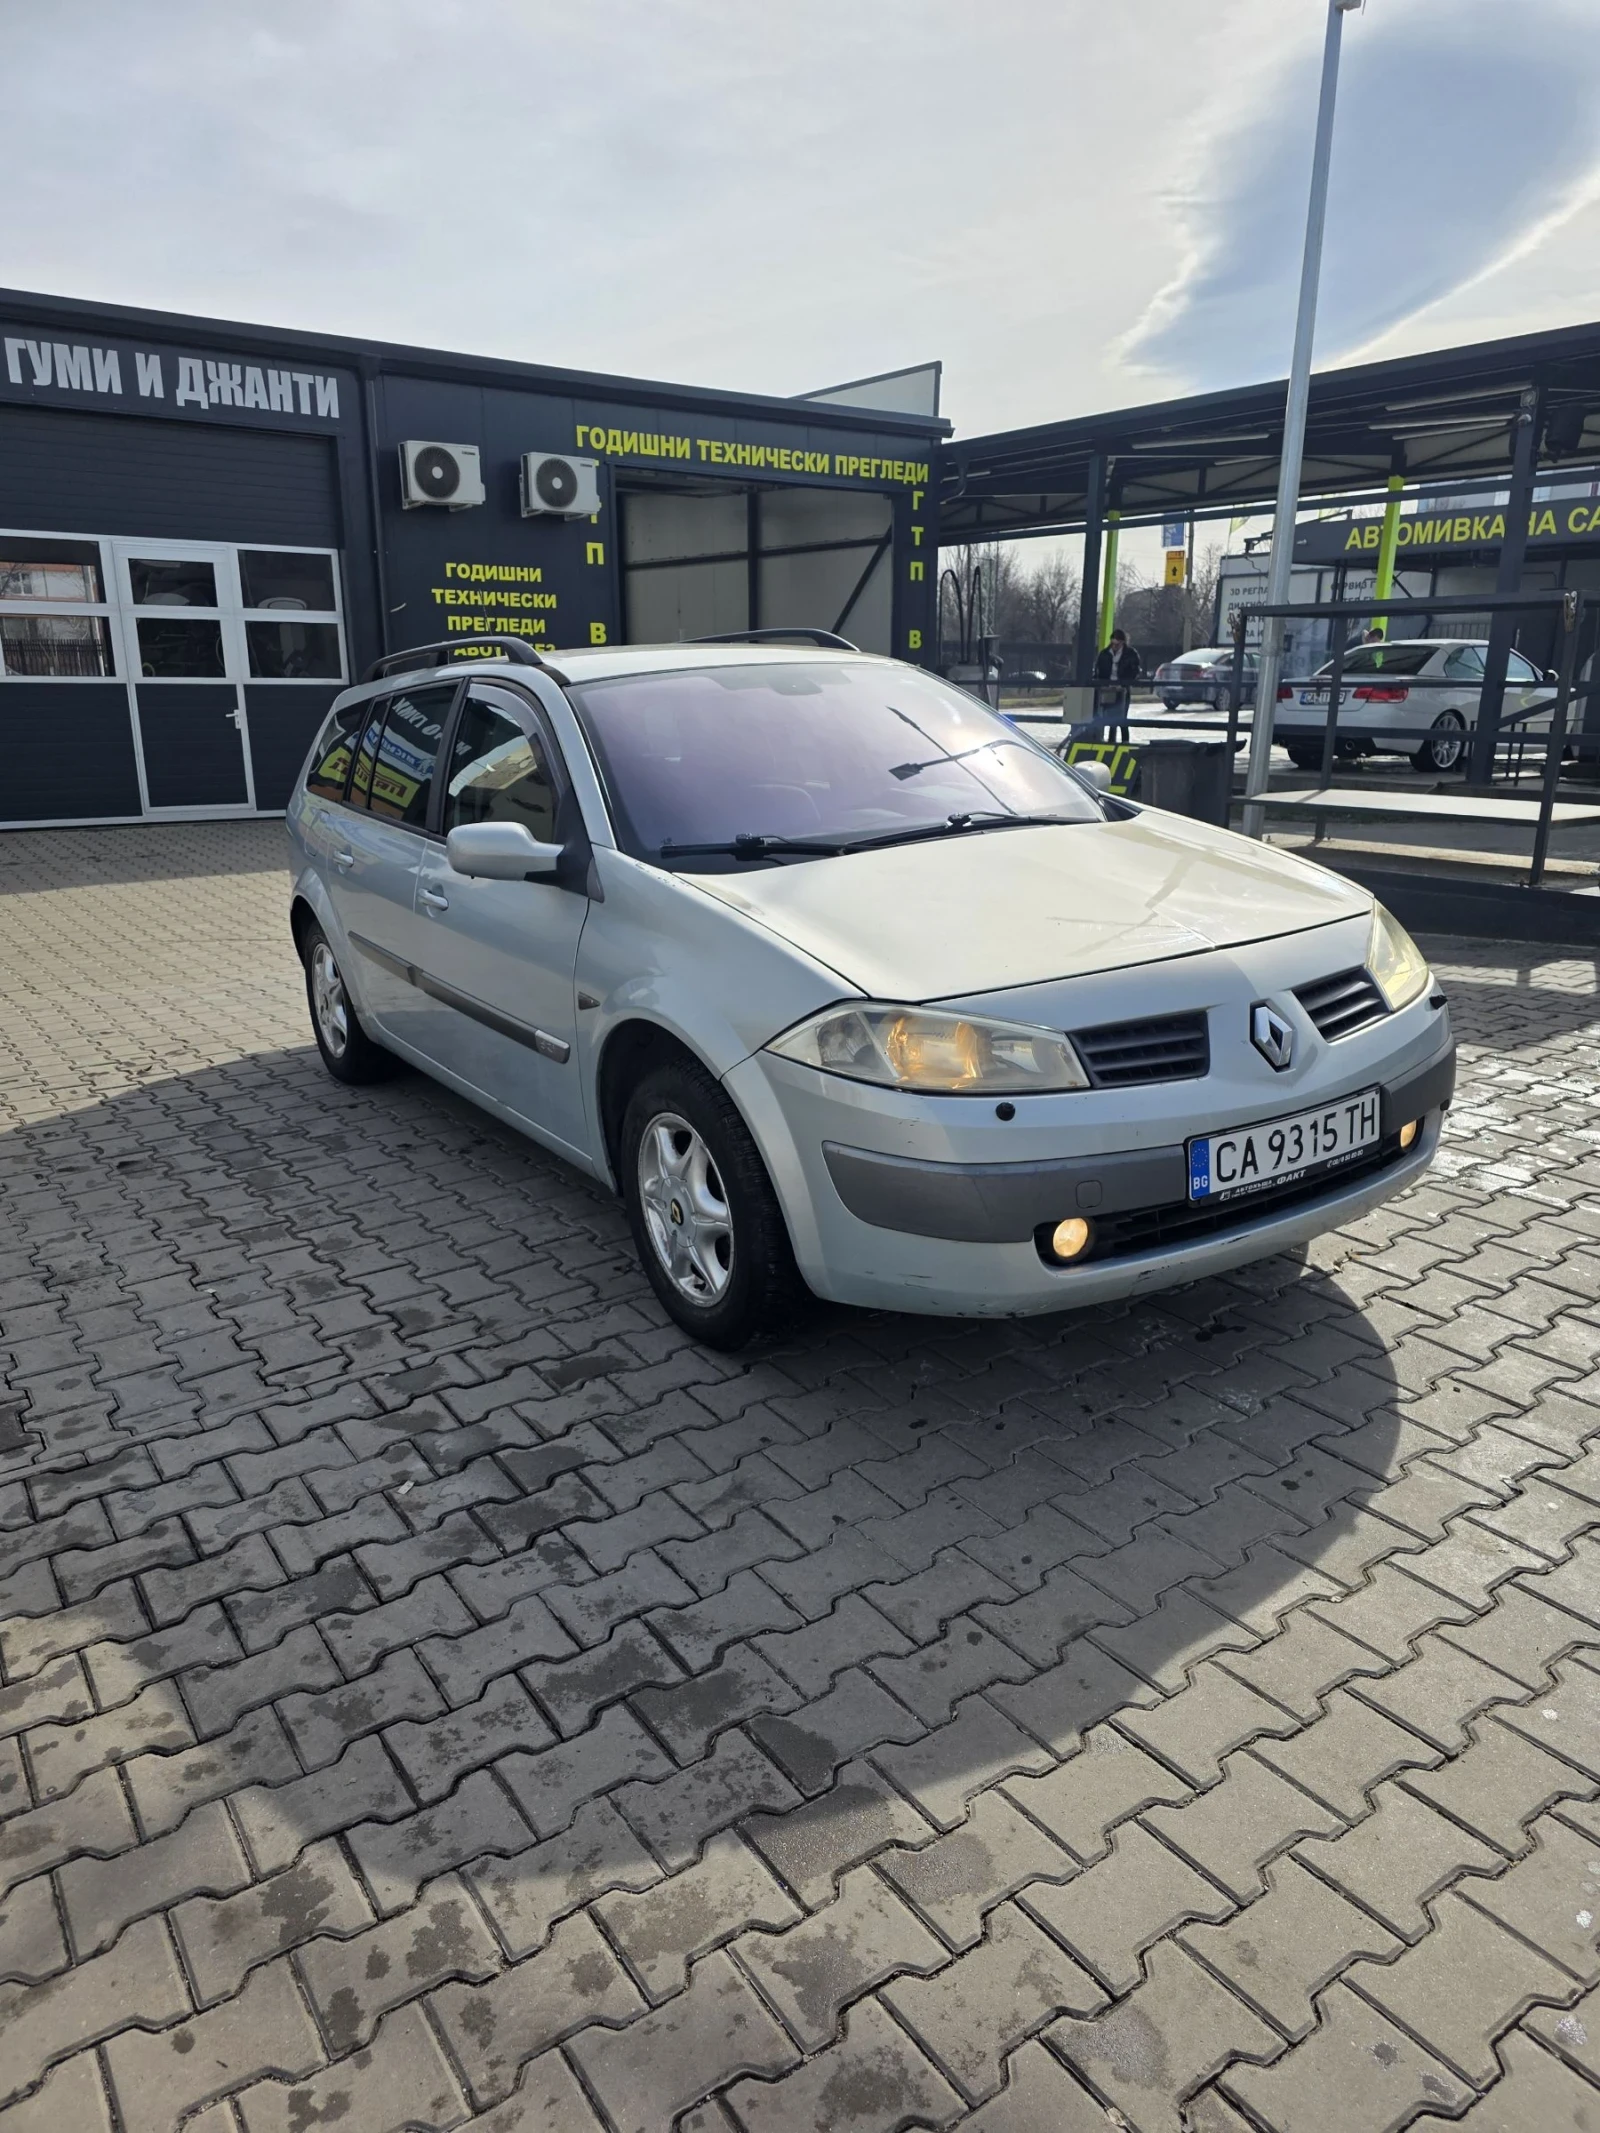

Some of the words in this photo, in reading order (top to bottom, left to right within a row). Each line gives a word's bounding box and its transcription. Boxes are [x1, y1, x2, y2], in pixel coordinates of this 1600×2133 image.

[4, 337, 123, 394] ГУМИ
[135, 352, 164, 398] И
[176, 356, 340, 418] ДЖАНТИ
[576, 425, 690, 459] ГОДИШНИ
[696, 439, 830, 474] ТЕХНИЧЕСКИ
[834, 454, 929, 485] ПРЕГЛЕДИ
[1344, 514, 1506, 550] АВОМИВКА
[445, 562, 542, 582] ГОДИШНИ
[431, 588, 557, 609] ТЕХНИЧЕСКИ
[447, 615, 546, 636] ПРЕГЛЕДИ
[1216, 1135, 1259, 1182] CA
[1268, 1111, 1338, 1170] 9315
[1345, 1098, 1376, 1144] TH
[1193, 1175, 1208, 1190] BG
[1277, 1169, 1306, 1185] ФАКТ
